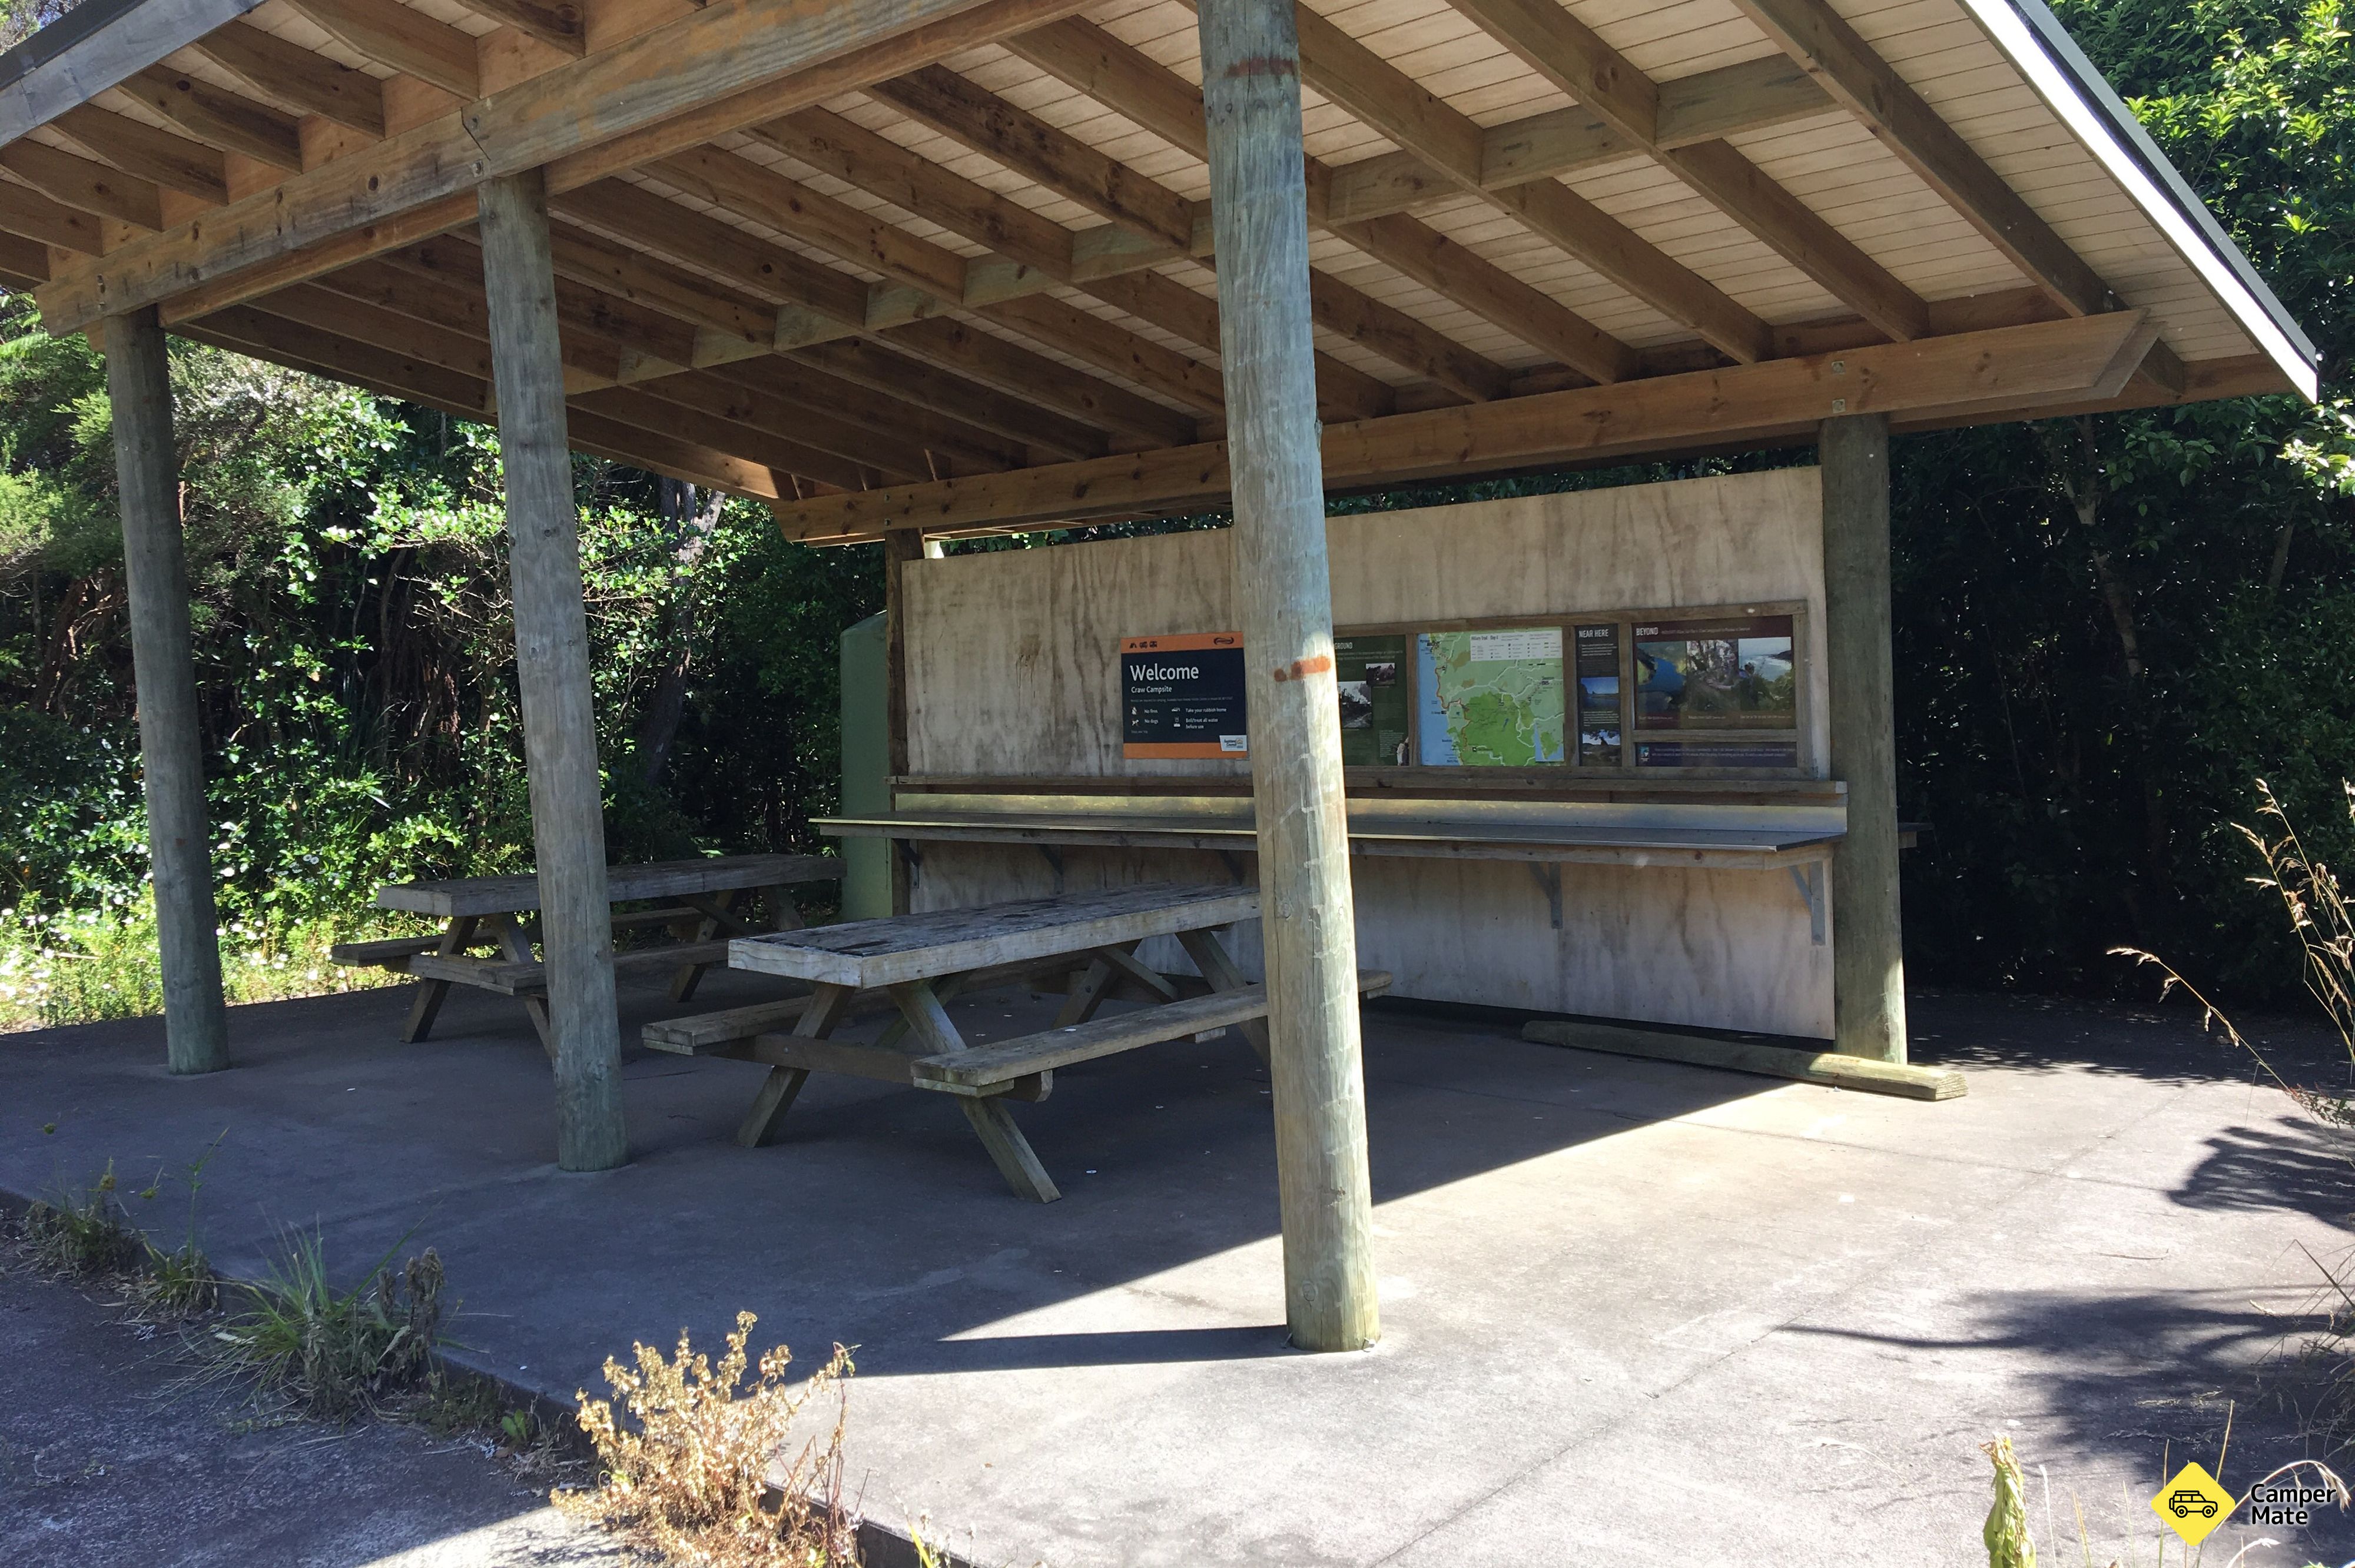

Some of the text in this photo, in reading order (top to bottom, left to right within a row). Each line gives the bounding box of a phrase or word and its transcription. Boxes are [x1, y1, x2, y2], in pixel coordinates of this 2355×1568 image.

[1579, 629, 1608, 638] NEAR HERE
[1636, 627, 1659, 636] BEYOND
[1130, 663, 1199, 681] Welcome
[1146, 685, 1172, 694] Campsite
